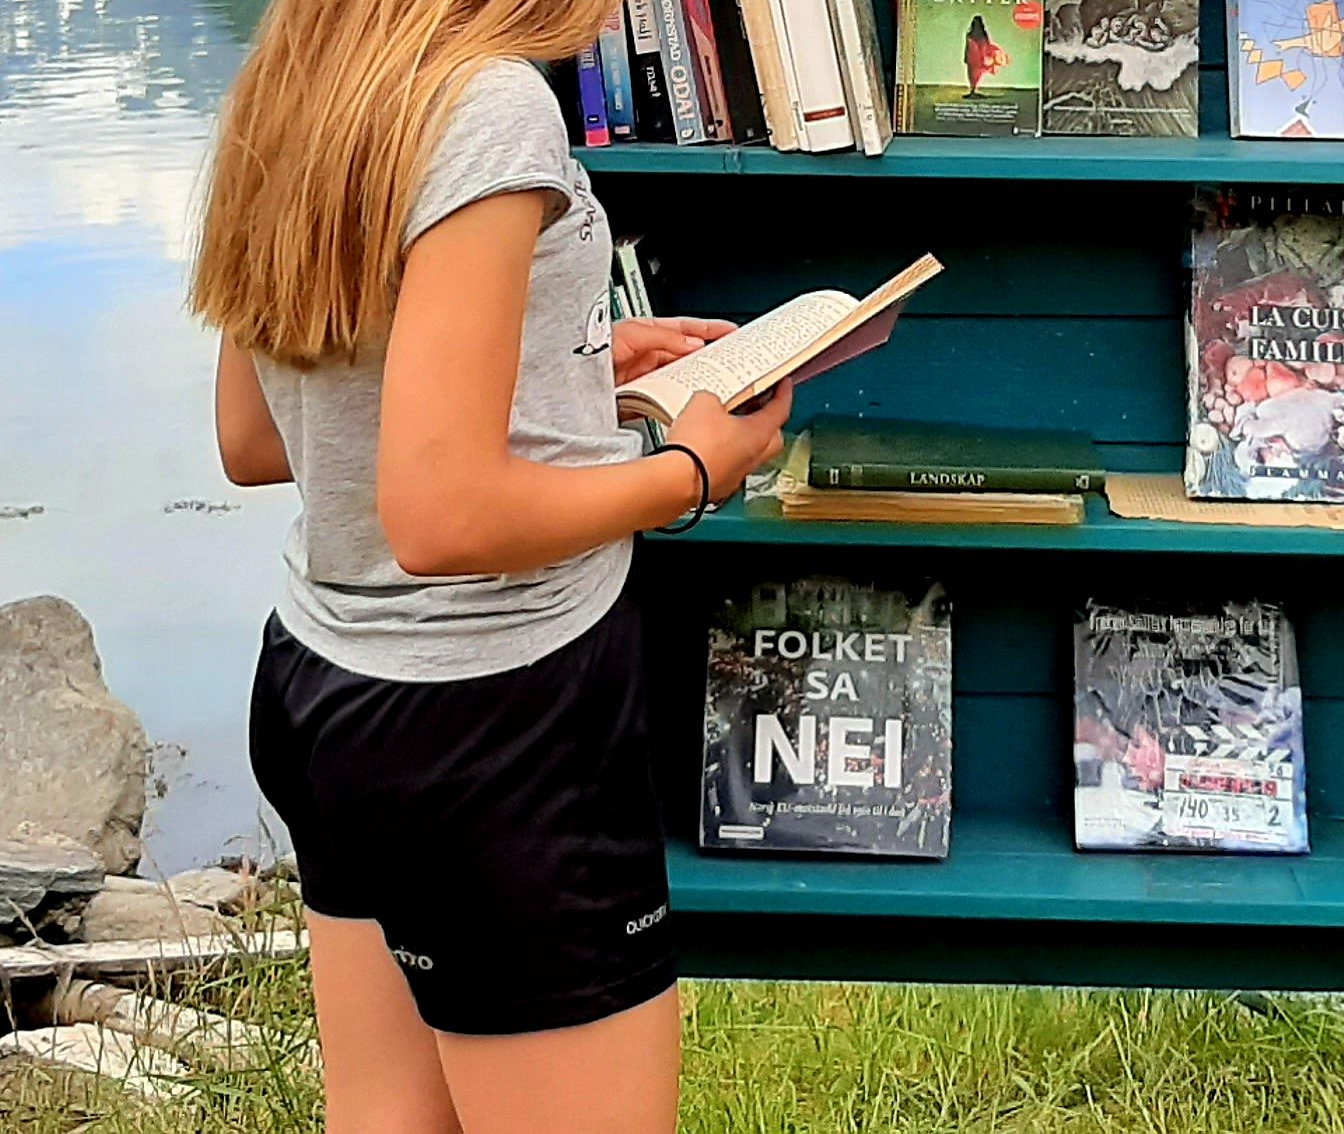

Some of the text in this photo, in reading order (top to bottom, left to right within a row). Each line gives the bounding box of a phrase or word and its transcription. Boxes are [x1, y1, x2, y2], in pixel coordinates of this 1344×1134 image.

[1250, 306, 1285, 328] LA
[910, 472, 986, 487] LANDSKAP
[754, 630, 913, 663] FOLKET
[805, 670, 859, 702] SA
[753, 714, 904, 789] NEI
[1179, 795, 1209, 819] 140
[1268, 805, 1282, 827] 2
